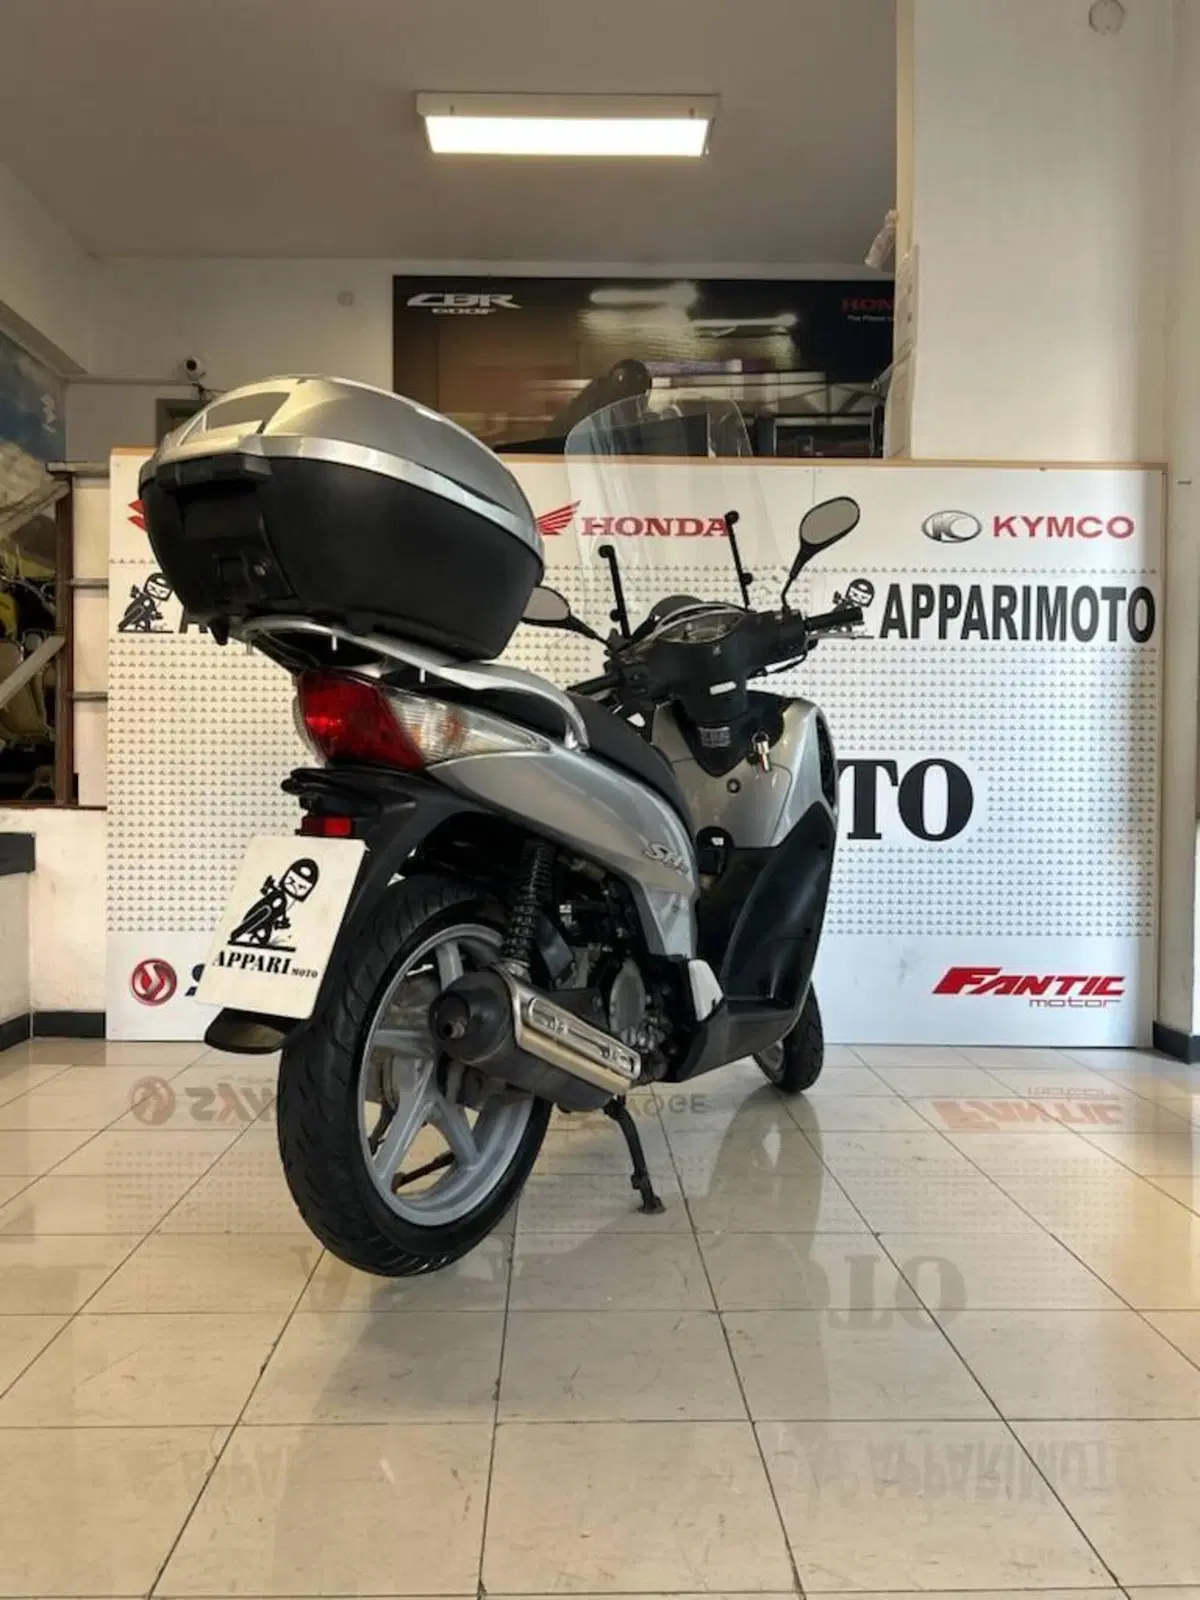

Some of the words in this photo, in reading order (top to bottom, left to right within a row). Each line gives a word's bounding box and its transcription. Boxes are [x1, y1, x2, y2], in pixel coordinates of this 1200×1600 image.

[407, 293, 522, 309] CBR
[581, 516, 729, 537] HONDA
[993, 515, 1135, 539] KYMCO
[879, 583, 1156, 643] APPARIMOTO
[212, 951, 291, 976] APPARI
[291, 967, 318, 979] MOTO
[932, 967, 1126, 996] FANTIC
[1029, 995, 1120, 1008] motor
